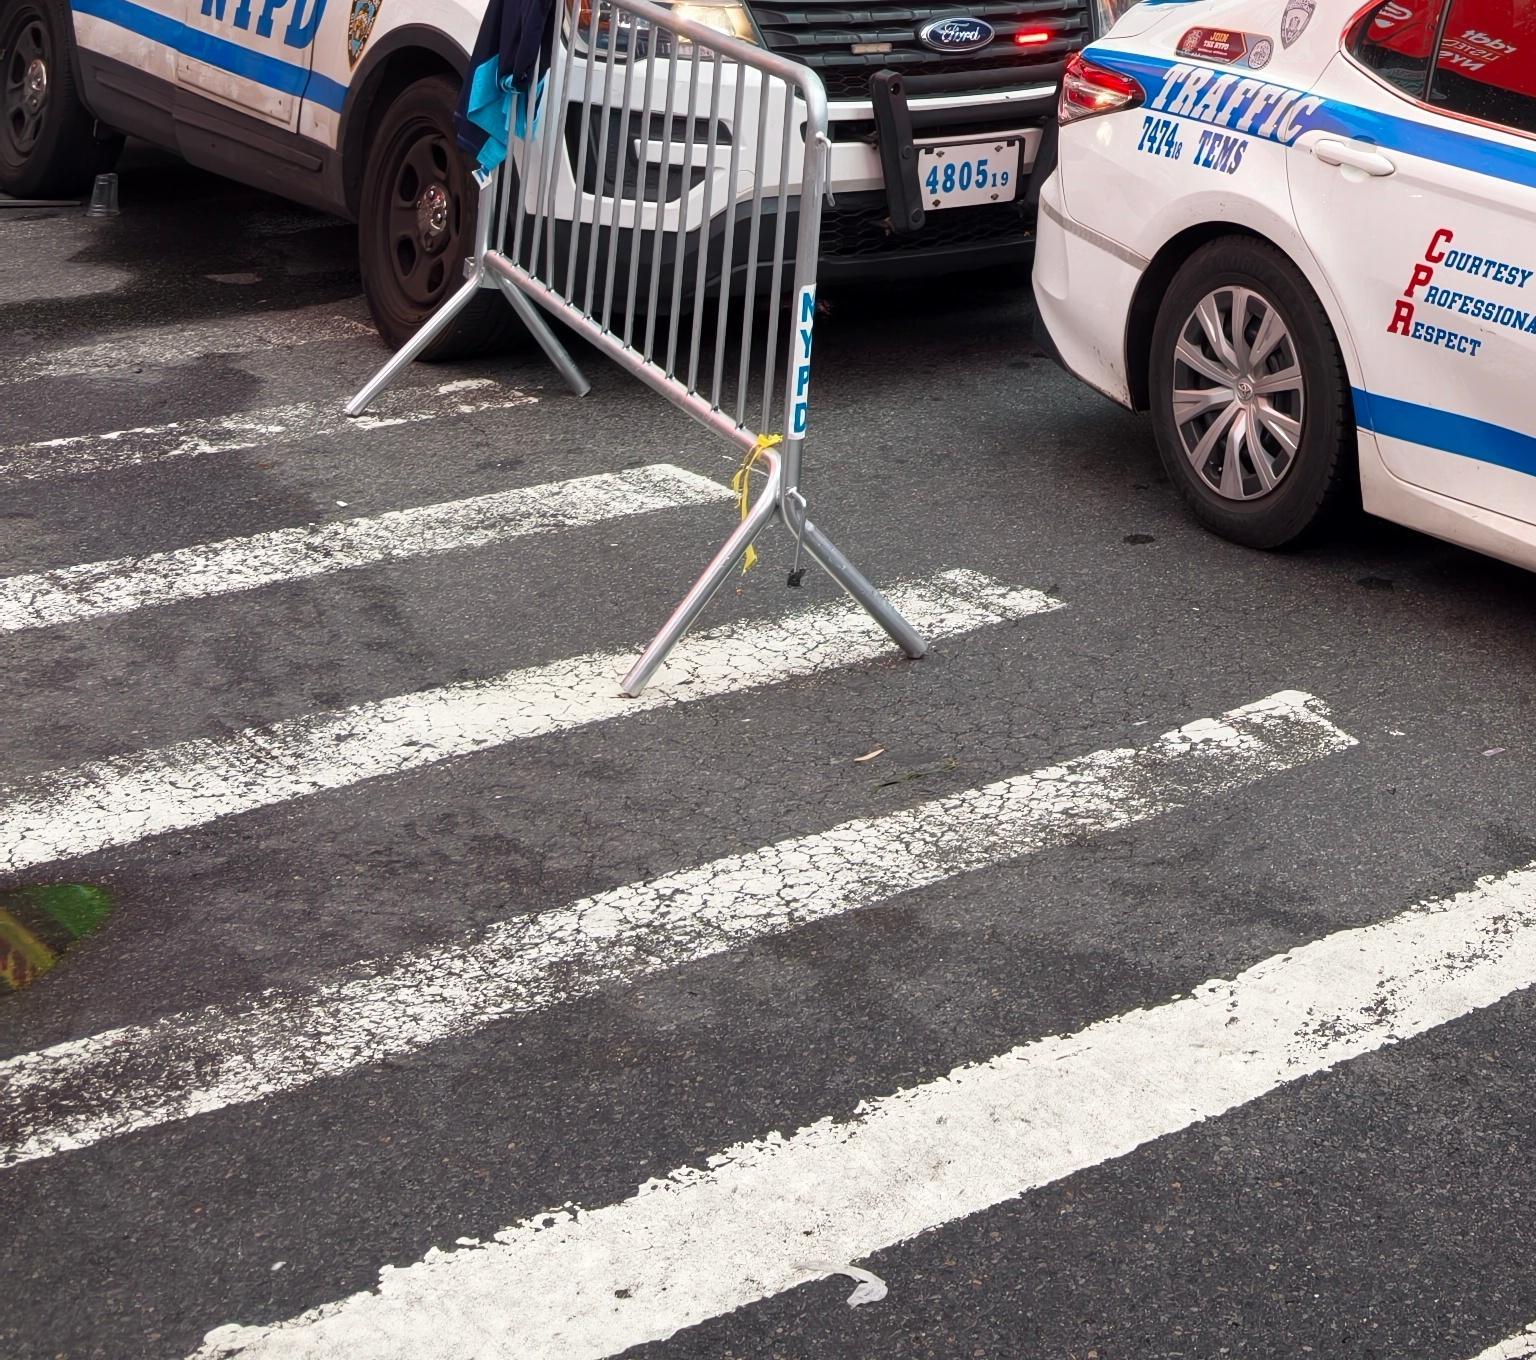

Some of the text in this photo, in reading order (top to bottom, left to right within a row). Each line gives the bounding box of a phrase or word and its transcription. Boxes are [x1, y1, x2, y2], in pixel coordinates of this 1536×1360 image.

[940, 22, 981, 42] Ford
[1209, 31, 1230, 42] JOIN
[1150, 63, 1322, 143] TRAFFIC
[1137, 116, 1178, 159] 7474
[1193, 130, 1248, 175] TEMS
[926, 159, 989, 195] 4805
[1424, 228, 1533, 289] COURTESY
[1386, 300, 1481, 357] RESPECT
[794, 293, 815, 435] NYPD
